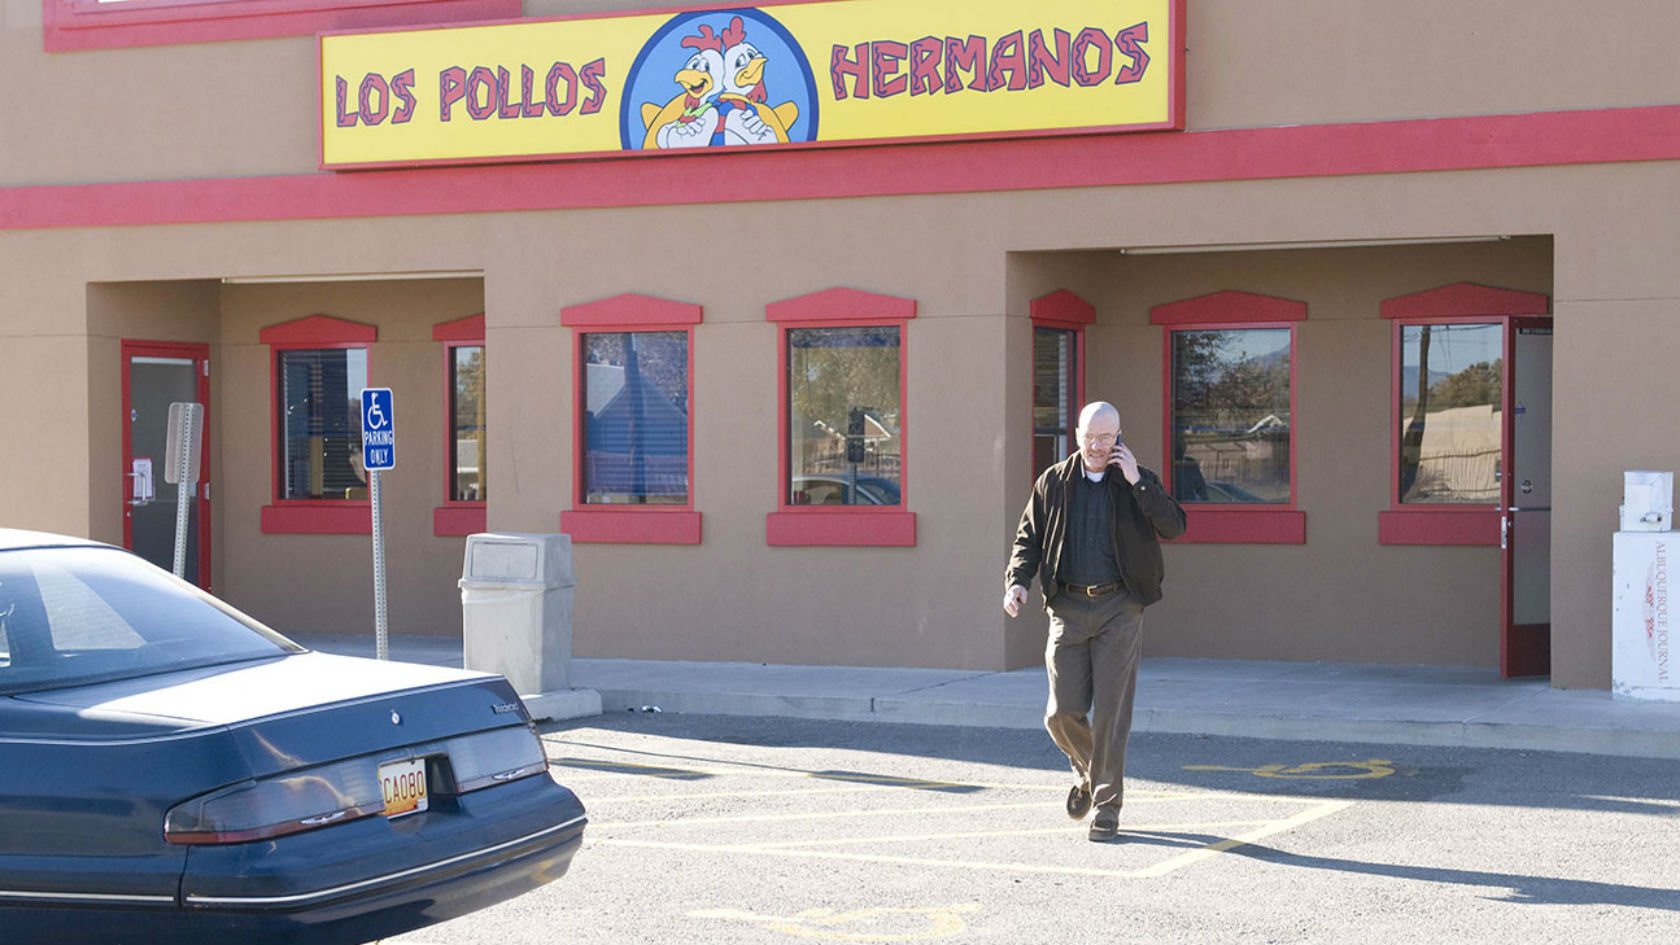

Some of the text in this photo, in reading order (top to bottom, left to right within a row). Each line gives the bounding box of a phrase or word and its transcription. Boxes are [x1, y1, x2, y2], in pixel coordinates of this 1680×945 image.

[336, 21, 1150, 127] LOS POLLOS HERMANOS
[365, 430, 393, 446] PARKING
[370, 448, 389, 465] ONLY
[1656, 541, 1669, 683] ALBUQUERQUE JOURNAL
[379, 770, 425, 804] CA080
